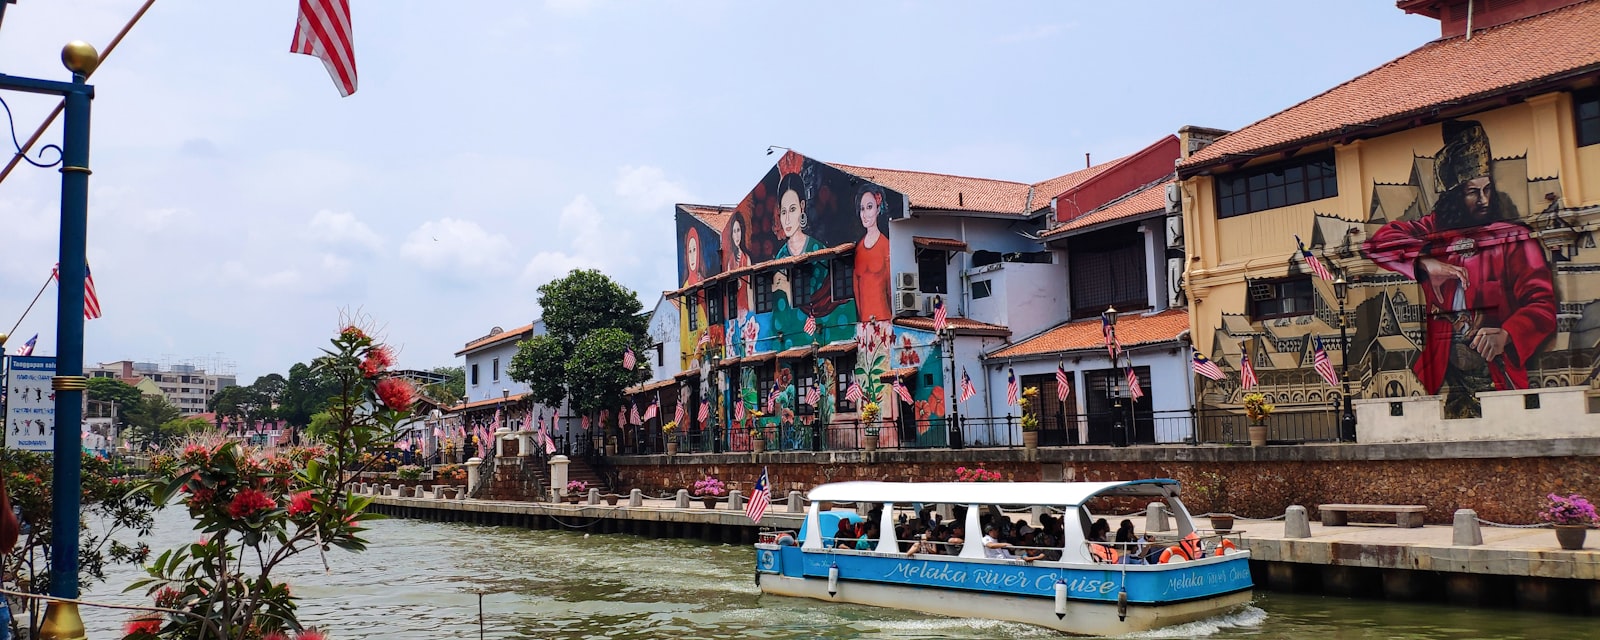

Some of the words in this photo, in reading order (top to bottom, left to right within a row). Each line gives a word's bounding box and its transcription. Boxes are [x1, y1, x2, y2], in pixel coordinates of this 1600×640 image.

[884, 561, 967, 583] Melaka
[973, 569, 1031, 588] River
[1163, 572, 1203, 595] Melaka
